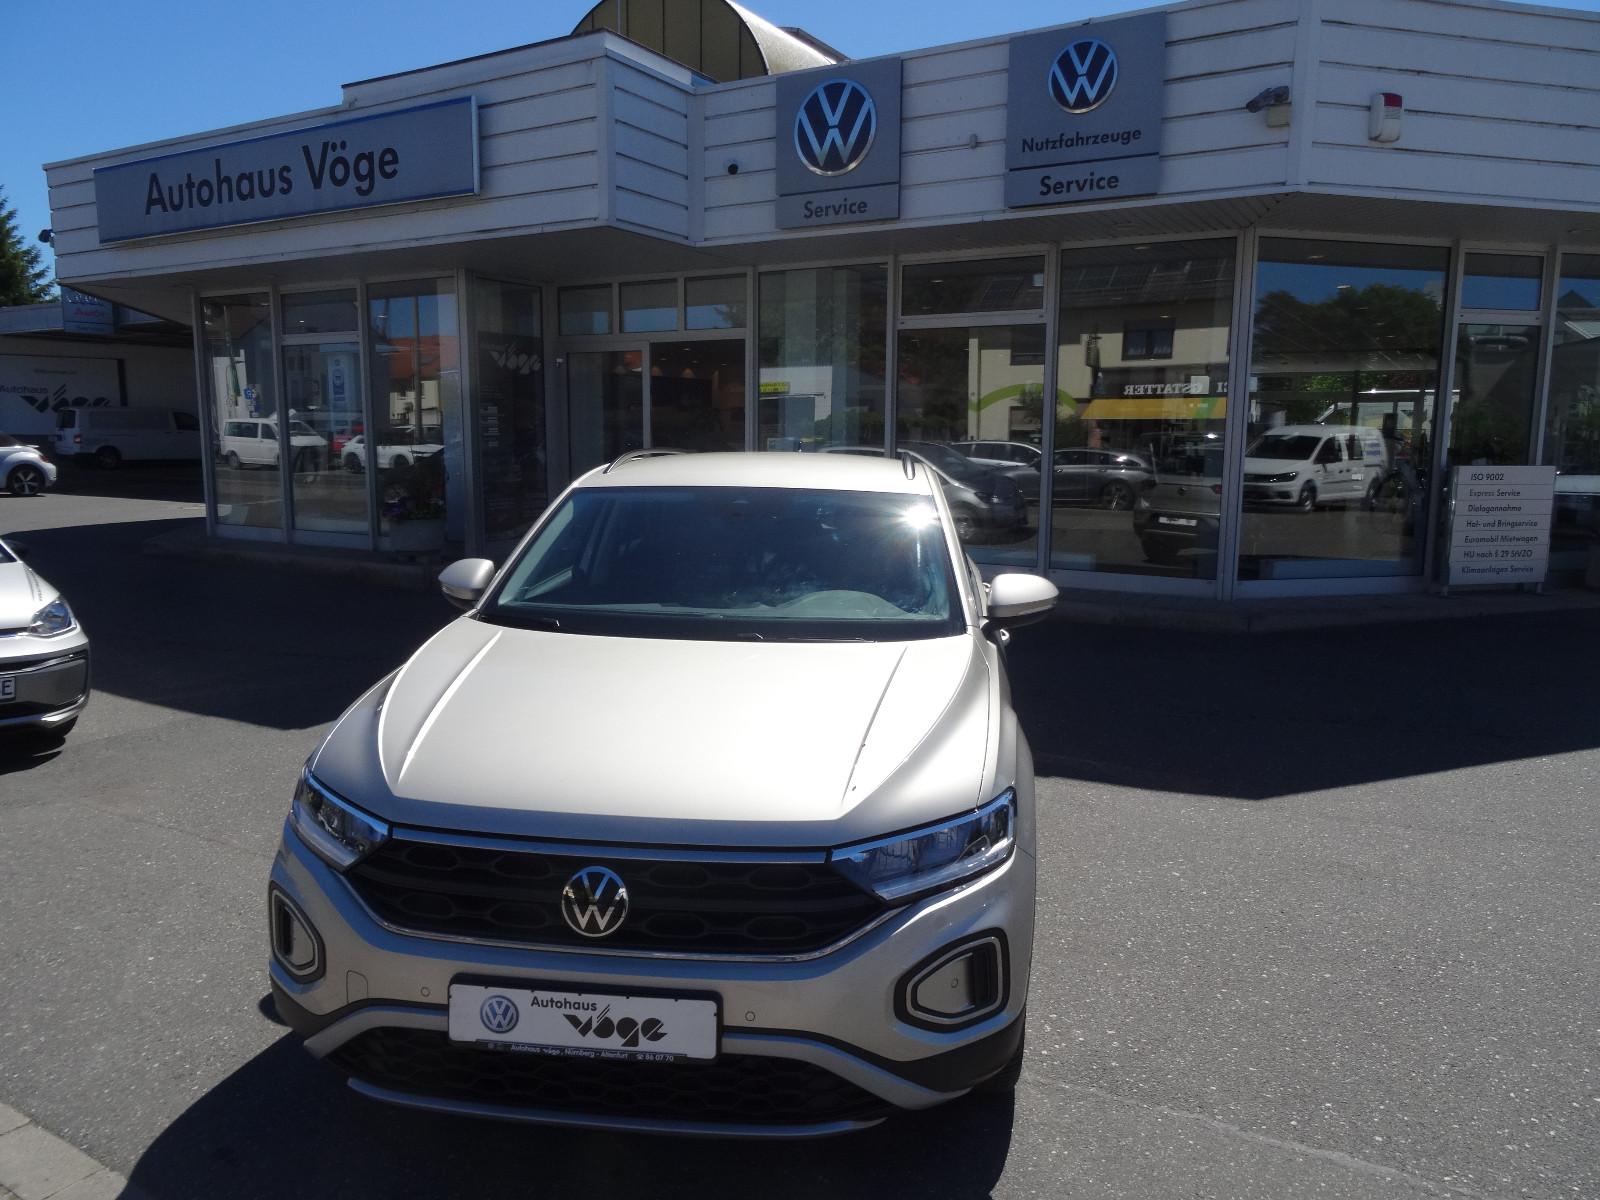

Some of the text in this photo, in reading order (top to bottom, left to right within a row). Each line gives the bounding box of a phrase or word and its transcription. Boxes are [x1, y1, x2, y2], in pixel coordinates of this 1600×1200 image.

[1047, 38, 1119, 114] VW
[794, 78, 877, 176] VW
[1022, 129, 1142, 153] Nutzfahrzeuge
[145, 140, 400, 215] Autohaus Vöge
[1039, 171, 1120, 196] Service
[803, 198, 868, 219] Service
[1470, 473, 1504, 481] ISO 9002
[1469, 489, 1521, 497] Express Service
[1467, 504, 1522, 513] Dialogannahme
[1497, 520, 1538, 529] Bringservice
[1464, 535, 1499, 544] Euromobil
[530, 996, 597, 1011] Autohaus
